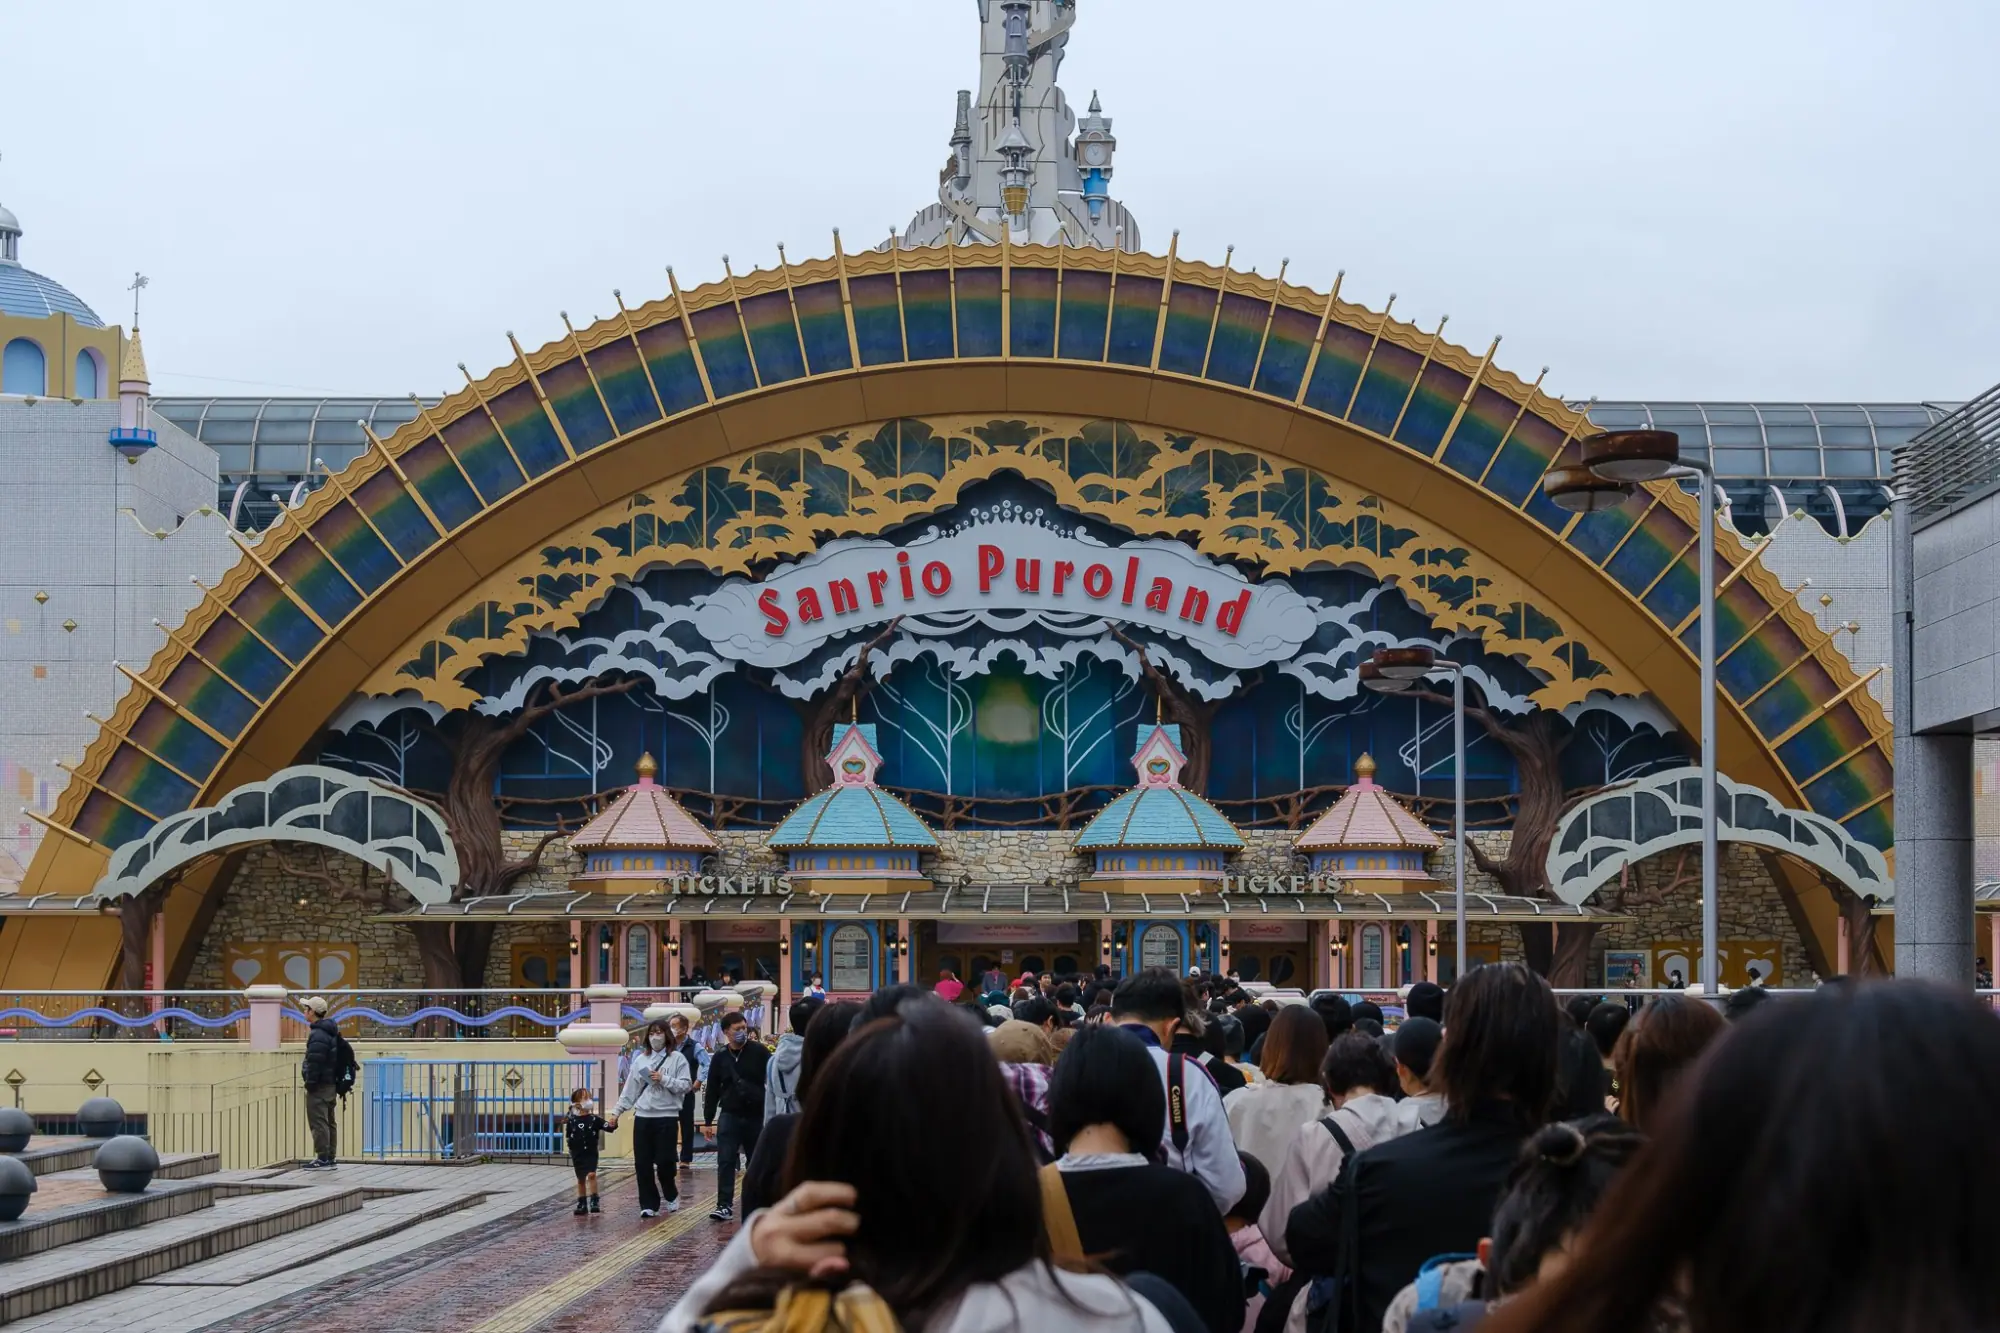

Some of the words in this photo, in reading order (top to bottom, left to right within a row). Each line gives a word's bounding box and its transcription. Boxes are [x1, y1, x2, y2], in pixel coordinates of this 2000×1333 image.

[757, 550, 953, 637] Sanrio
[978, 544, 1253, 638] Puroland
[668, 875, 793, 895] TICKETS
[1219, 875, 1342, 894] TICKETS
[1171, 1085, 1182, 1123] Canon
